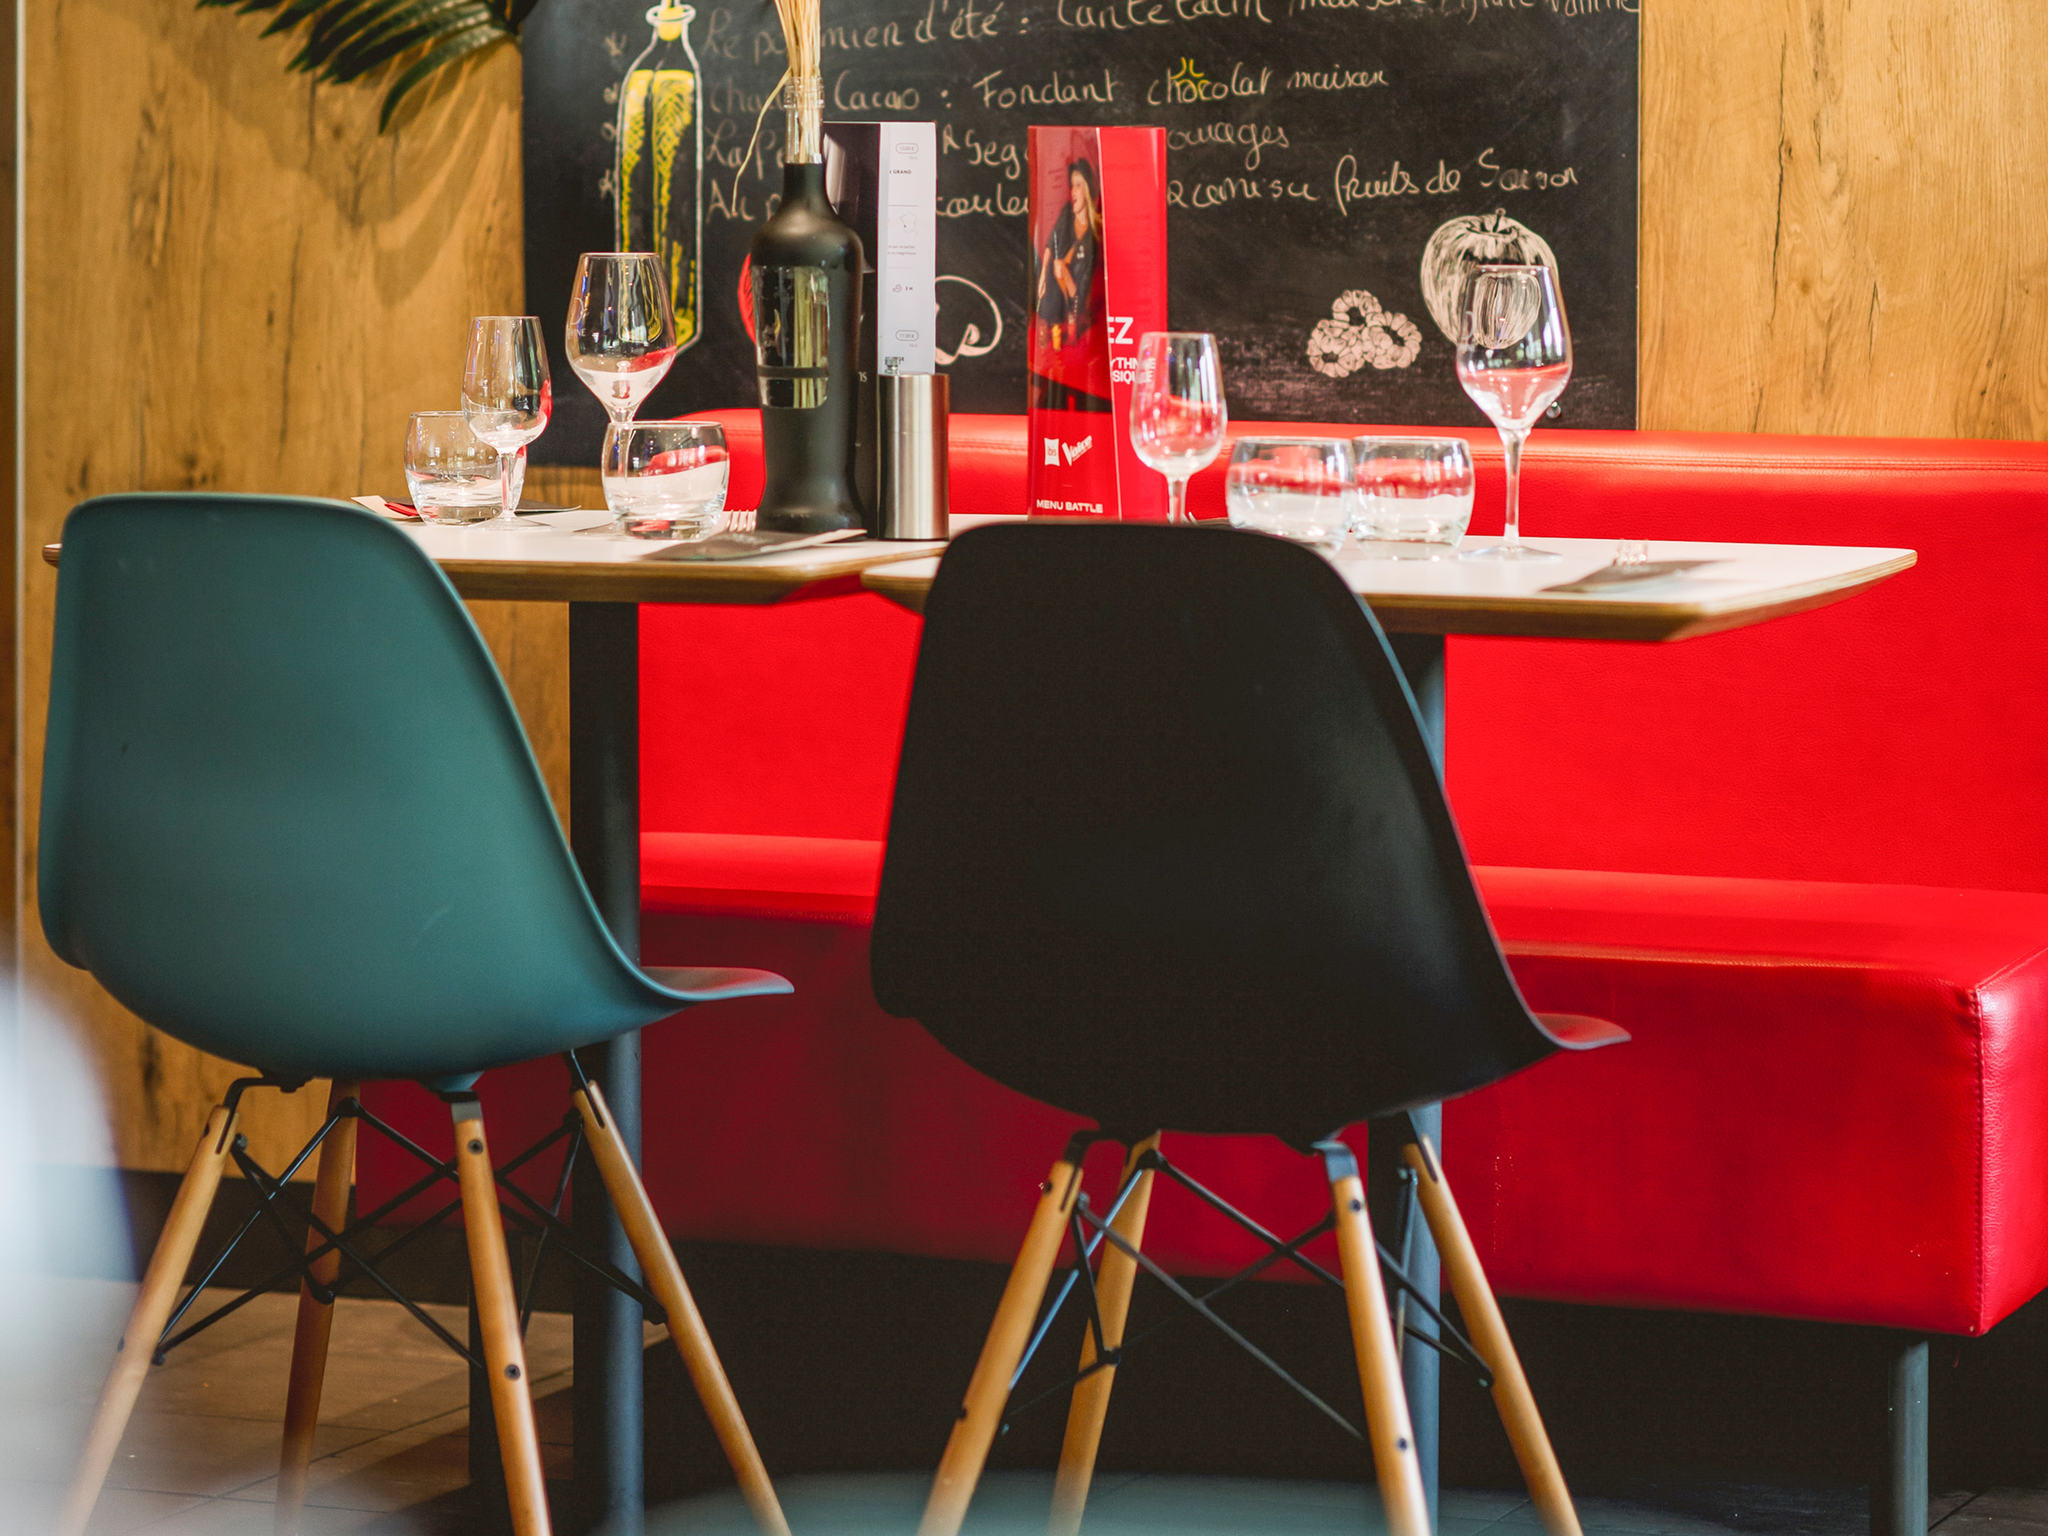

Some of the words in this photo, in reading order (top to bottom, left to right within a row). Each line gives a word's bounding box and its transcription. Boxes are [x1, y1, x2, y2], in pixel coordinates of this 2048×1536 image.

[833, 69, 920, 111] Cacao
[972, 70, 1118, 108] Fondant
[1425, 159, 1461, 194] de
[1036, 499, 1064, 510] MENU
[1065, 501, 1104, 514] BATTLE
